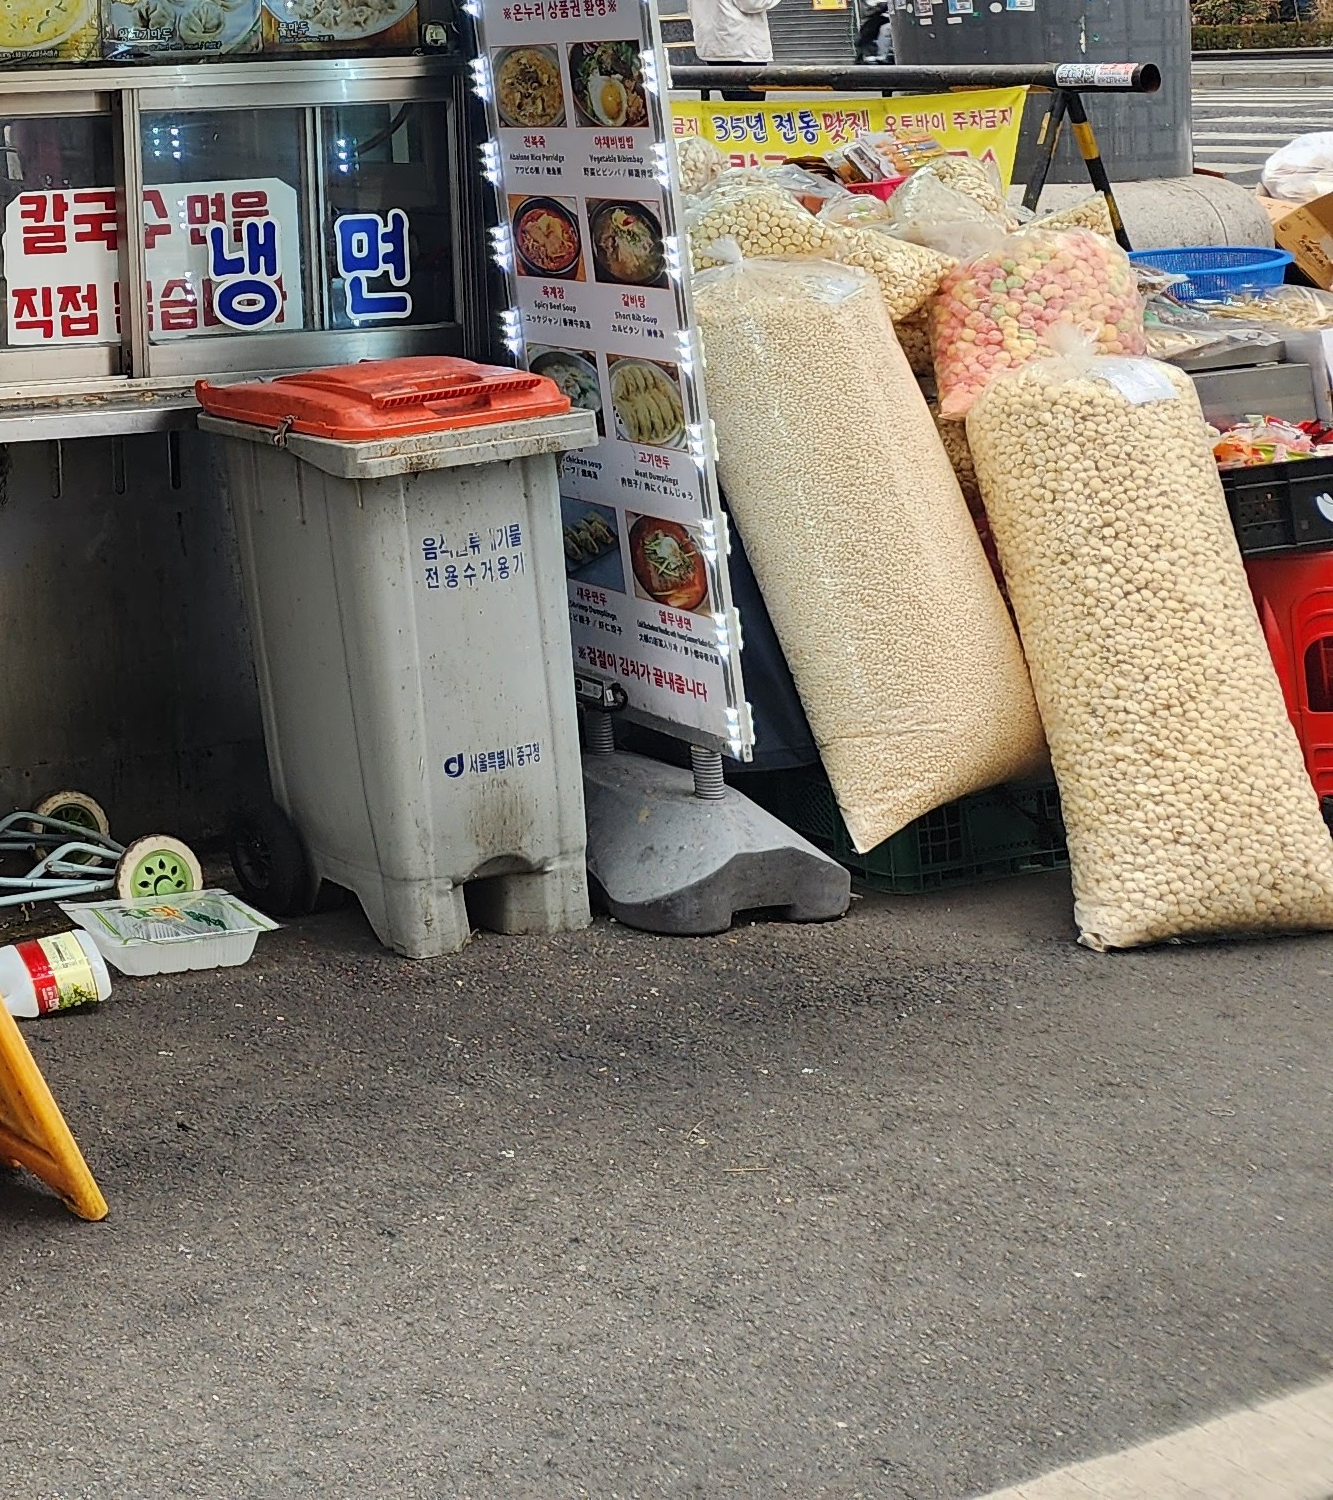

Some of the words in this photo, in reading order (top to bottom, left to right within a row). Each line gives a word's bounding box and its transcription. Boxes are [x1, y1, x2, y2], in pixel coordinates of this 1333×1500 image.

[547, 0, 581, 19] 상품권
[672, 117, 698, 134] 금지
[712, 114, 766, 140] 35년
[885, 112, 945, 132] 오토바이
[952, 107, 1014, 129] 주차금지
[12, 284, 98, 338] 직접
[621, 293, 646, 308] 갈비탕
[638, 452, 670, 469] 고기만두
[653, 668, 708, 702] 끝내줍니다
[469, 750, 514, 773] 서울특별시
[517, 743, 540, 767] 중구청
